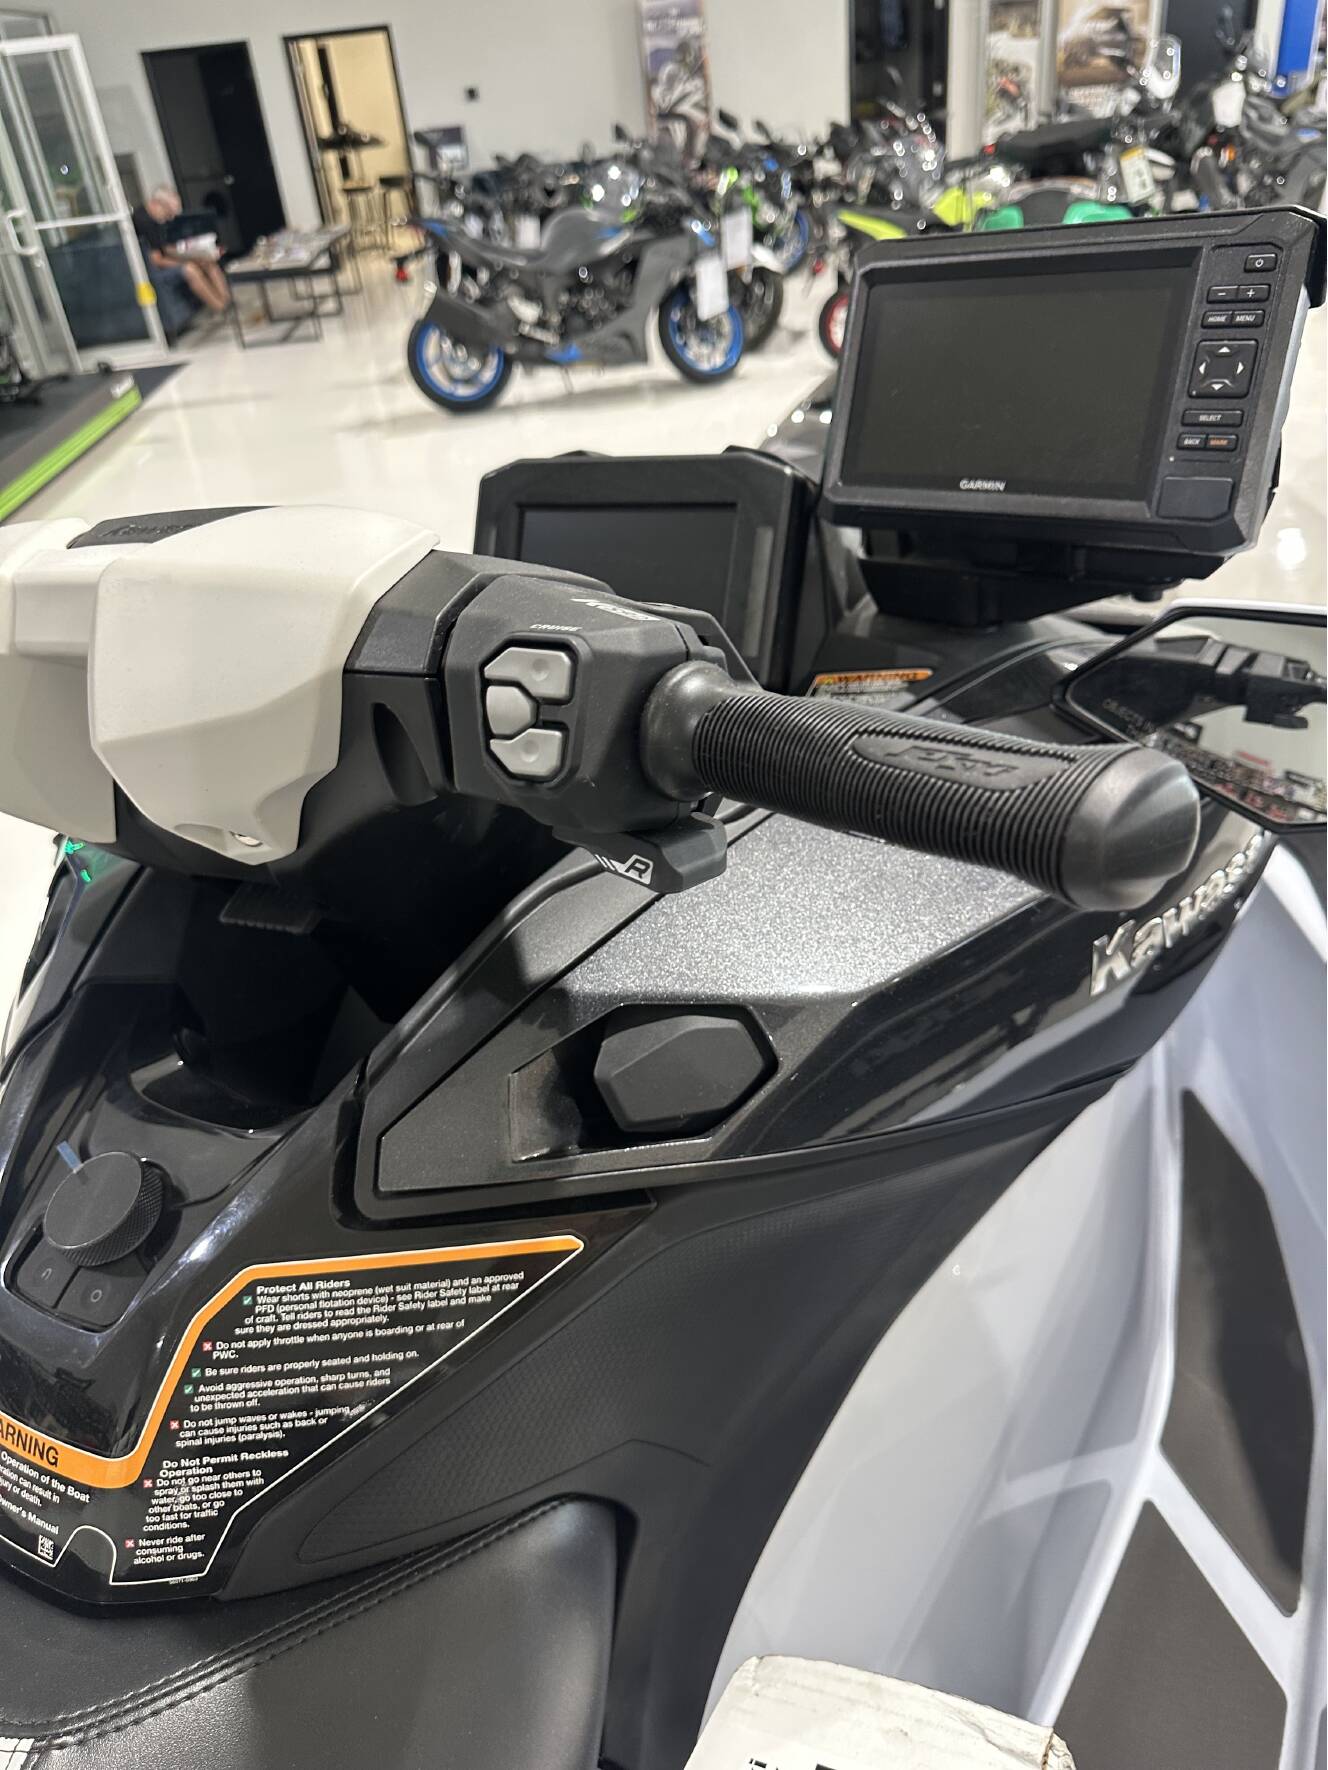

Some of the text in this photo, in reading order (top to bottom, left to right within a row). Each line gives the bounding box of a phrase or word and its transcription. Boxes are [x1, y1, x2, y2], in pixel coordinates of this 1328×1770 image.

[1184, 438, 1200, 446] BACK
[960, 478, 1007, 492] GARMIN
[624, 858, 650, 879] R
[257, 1280, 350, 1294] Protect All Riders
[257, 1295, 279, 1304] Wear
[282, 1292, 310, 1301] shorts
[312, 1290, 330, 1298] with
[332, 1286, 373, 1298] neoprene
[375, 1284, 394, 1294] (wet
[396, 1282, 411, 1291] suit
[414, 1278, 451, 1290] material)
[453, 1277, 469, 1286] and
[484, 1271, 524, 1284] approved
[255, 1304, 274, 1314] PFD
[276, 1301, 317, 1314] (personal
[319, 1298, 355, 1308] flotation
[357, 1295, 388, 1306] device)
[397, 1293, 412, 1301] see
[414, 1289, 436, 1299] Rider
[440, 1286, 466, 1297] Safety
[469, 1285, 490, 1293] label
[502, 1283, 519, 1291] rear
[245, 1294, 491, 1325] of craft. Tell riders to read the Rider Safety label and make
[234, 1314, 389, 1335] sure they are dressed appropriately.
[216, 1342, 229, 1350] Do
[231, 1340, 245, 1348] not
[247, 1338, 271, 1349] apply
[274, 1335, 304, 1345] throttle
[306, 1334, 330, 1343] when
[332, 1331, 364, 1343] anyone
[366, 1329, 373, 1337] is
[375, 1325, 414, 1337] boarding
[426, 1322, 435, 1331] at
[437, 1322, 453, 1331] rear
[456, 1319, 465, 1327] of
[205, 1350, 419, 1376] Be sure riders are properly seated and holding on.
[213, 1351, 238, 1360] PWC.
[194, 1390, 245, 1402] unexpected
[247, 1386, 300, 1398] acceleration
[302, 1385, 318, 1393] that
[338, 1380, 364, 1390] cause
[366, 1378, 390, 1386] riders
[198, 1384, 224, 1393] Avoid
[226, 1379, 272, 1390] aggressive
[275, 1375, 318, 1386] operation,
[320, 1372, 346, 1382] sharp
[374, 1368, 390, 1376] and
[190, 1399, 260, 1412] to be thrown off.
[184, 1419, 196, 1428] Do
[198, 1419, 213, 1427] not
[215, 1416, 237, 1426] jump
[239, 1414, 266, 1423] waves
[280, 1410, 307, 1419] wakes
[314, 1405, 350, 1418] jumping
[179, 1417, 328, 1438] can cause injuries such as back or
[0, 1421, 59, 1467] ARNING
[176, 1430, 285, 1448] spinal injuries (paralysis).
[163, 1449, 289, 1468] Do Not Permit Reckless
[1, 1451, 91, 1503] Operation of the Boat
[156, 1478, 169, 1486] Do
[188, 1475, 199, 1485] go
[202, 1473, 221, 1482] near
[223, 1470, 250, 1480] others
[160, 1466, 212, 1478] Operation
[19, 1476, 32, 1489] can
[32, 1485, 52, 1500] result
[53, 1493, 60, 1504] in
[192, 1482, 220, 1492] splash
[222, 1479, 244, 1488] them
[246, 1476, 264, 1485] with
[13, 1484, 21, 1494] or
[21, 1490, 42, 1507] death.
[179, 1496, 190, 1504] go
[192, 1492, 207, 1501] too
[233, 1488, 243, 1496] to
[146, 1509, 218, 1523] too fast for traffic
[148, 1504, 171, 1514] other
[173, 1503, 200, 1512] boats,
[213, 1500, 225, 1509] go
[28, 1512, 59, 1535] Manual
[143, 1521, 190, 1532] conditions.
[139, 1533, 205, 1546] Never ride after
[133, 1554, 164, 1565] alcohol
[177, 1551, 205, 1561] drugs.
[136, 1544, 184, 1555] consuming
